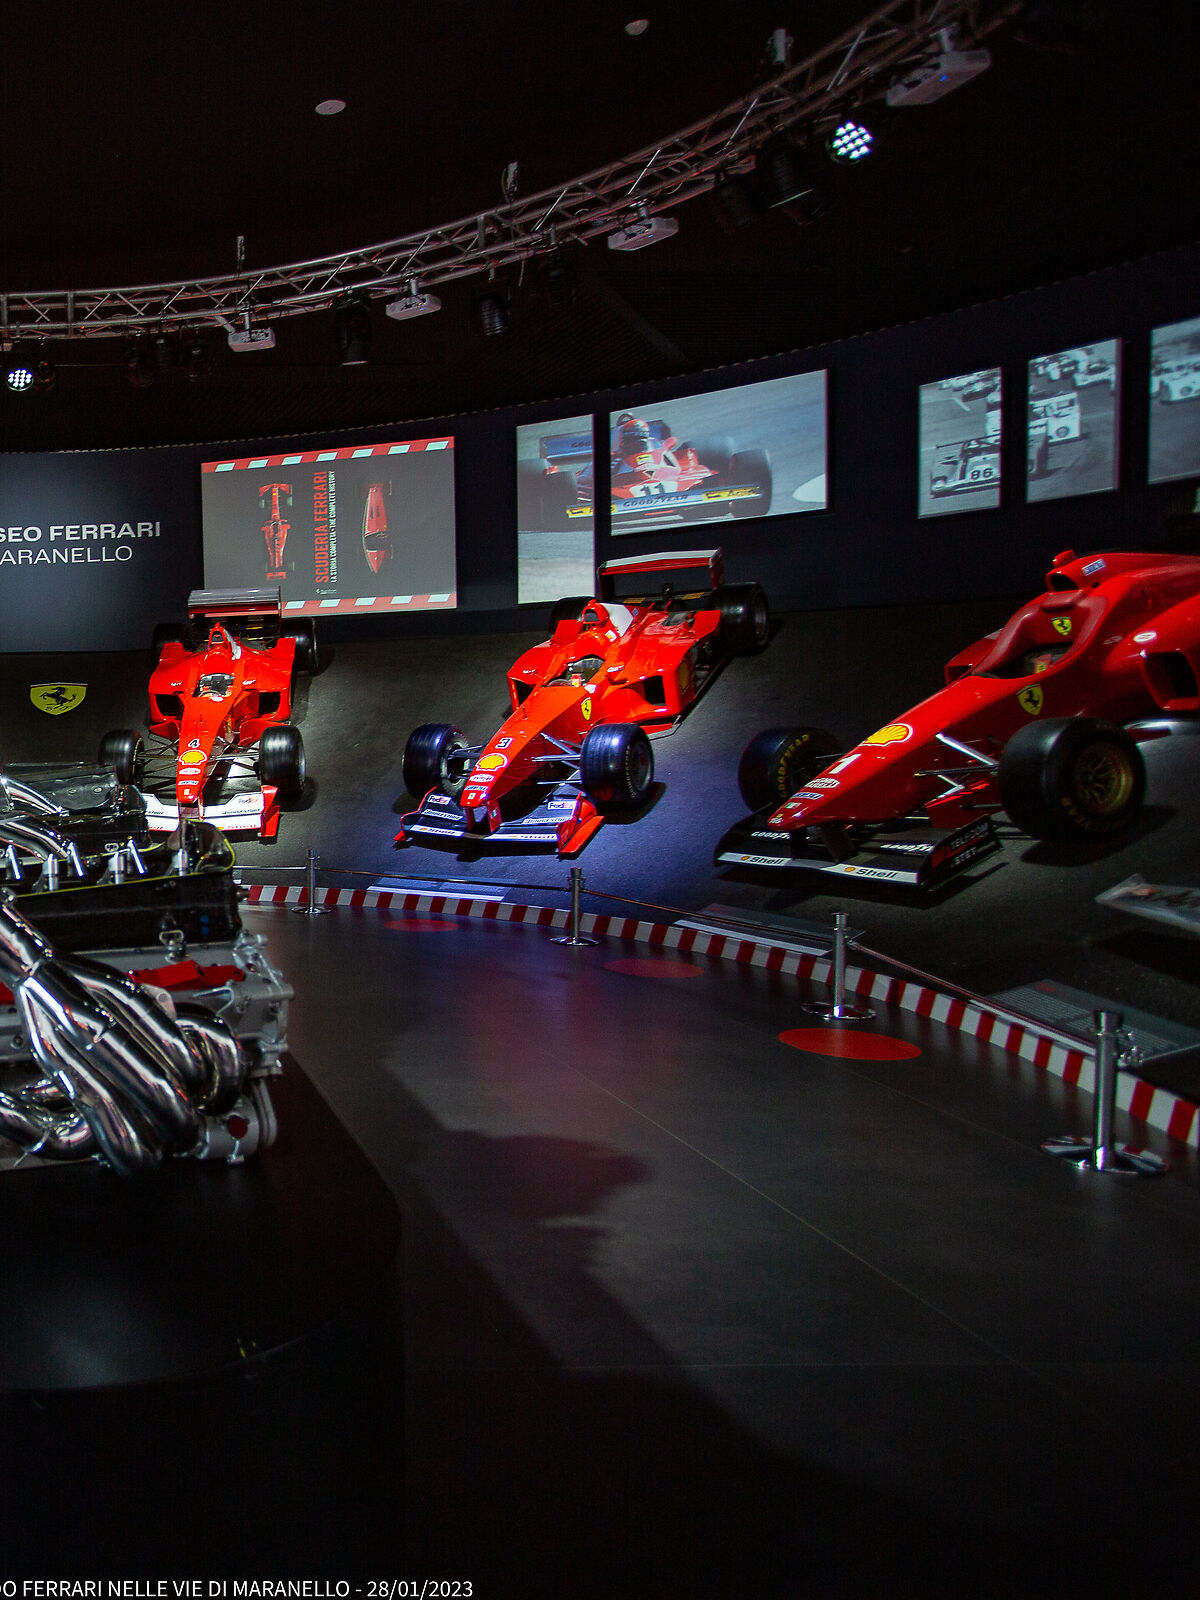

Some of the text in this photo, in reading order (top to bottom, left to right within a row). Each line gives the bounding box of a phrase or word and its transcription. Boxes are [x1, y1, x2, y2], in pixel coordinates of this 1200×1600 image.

[971, 467, 994, 480] 86
[313, 471, 328, 521] FERRARI
[640, 482, 666, 496] 11
[623, 494, 689, 508] GOODYEAR
[50, 521, 161, 541] FERRARI
[314, 524, 329, 583] SCUDERIA
[188, 738, 201, 749] 4
[828, 753, 862, 775] 1
[750, 856, 784, 865] Shell
[856, 867, 899, 878] Shell
